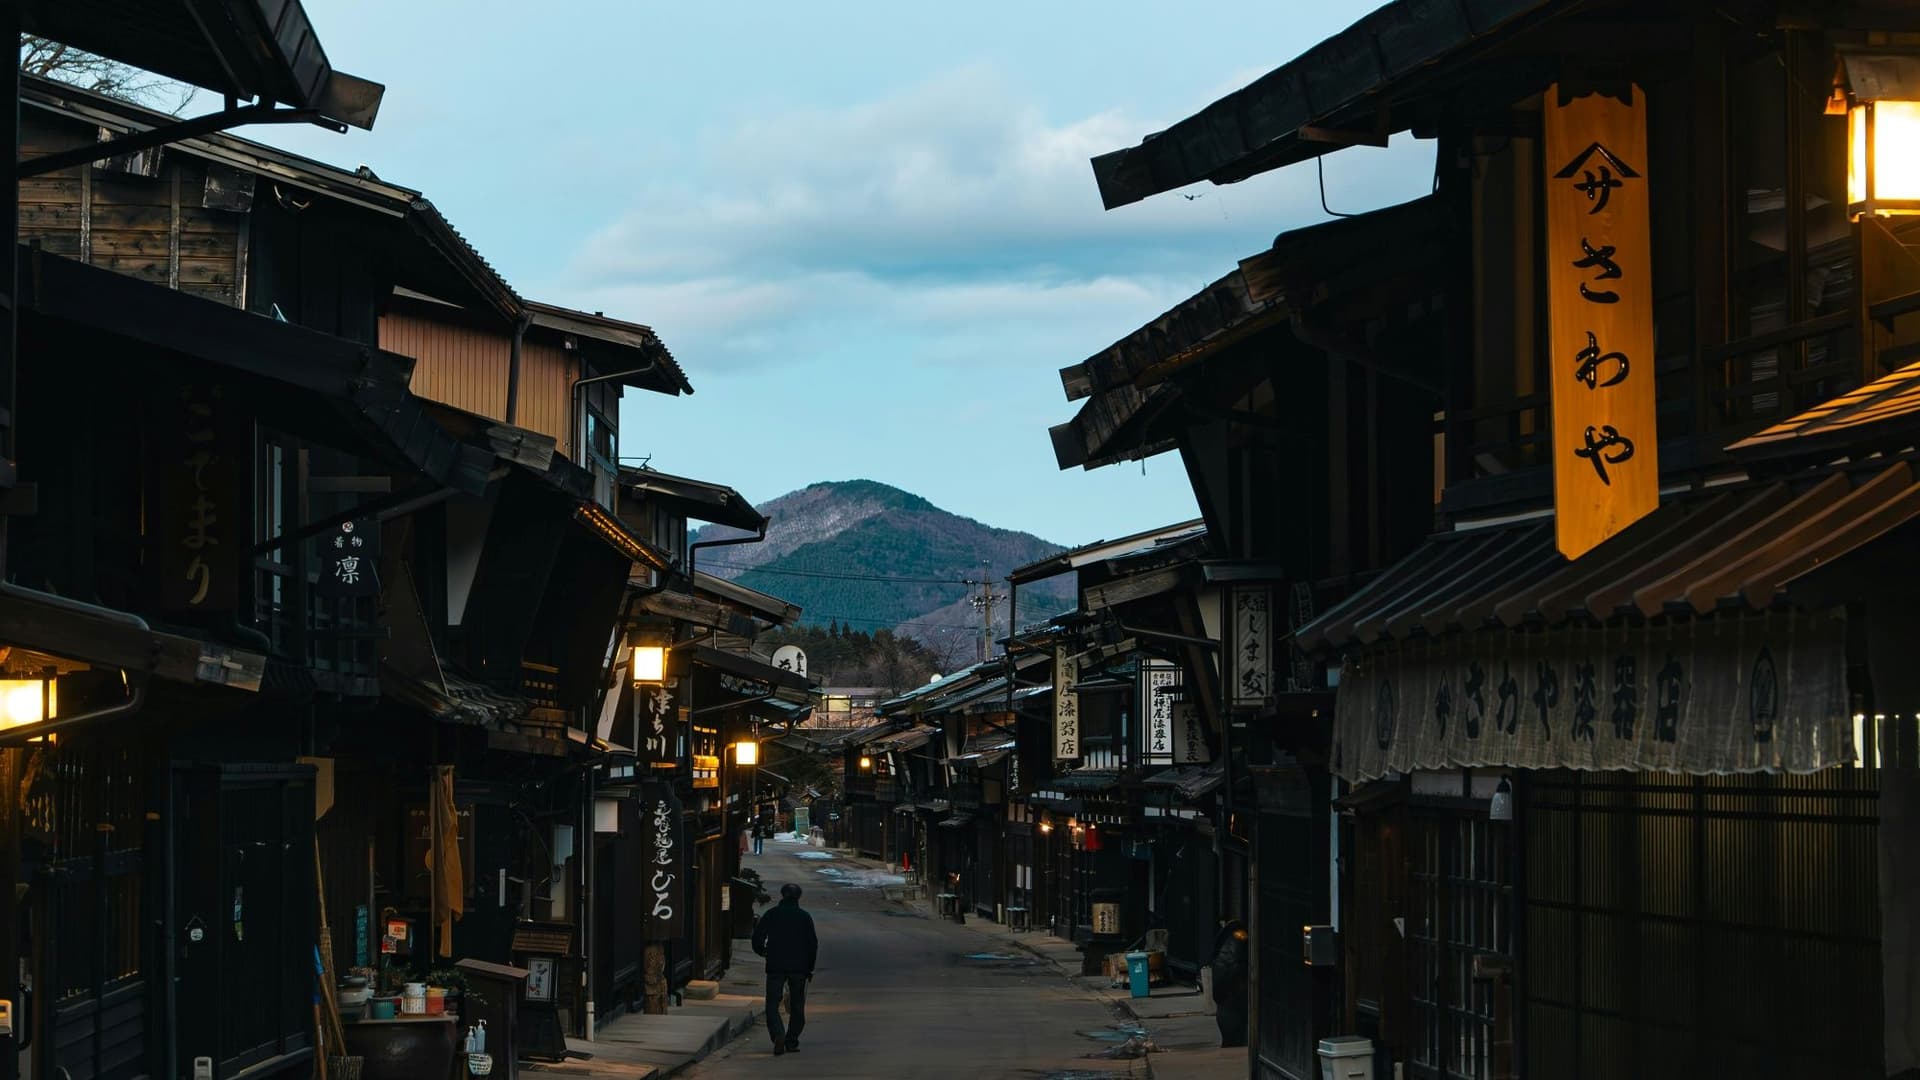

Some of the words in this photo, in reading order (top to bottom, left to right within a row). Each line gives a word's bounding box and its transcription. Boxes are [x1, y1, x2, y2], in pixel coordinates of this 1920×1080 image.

[1572, 237, 1635, 487] さわや
[334, 555, 361, 585] 凛
